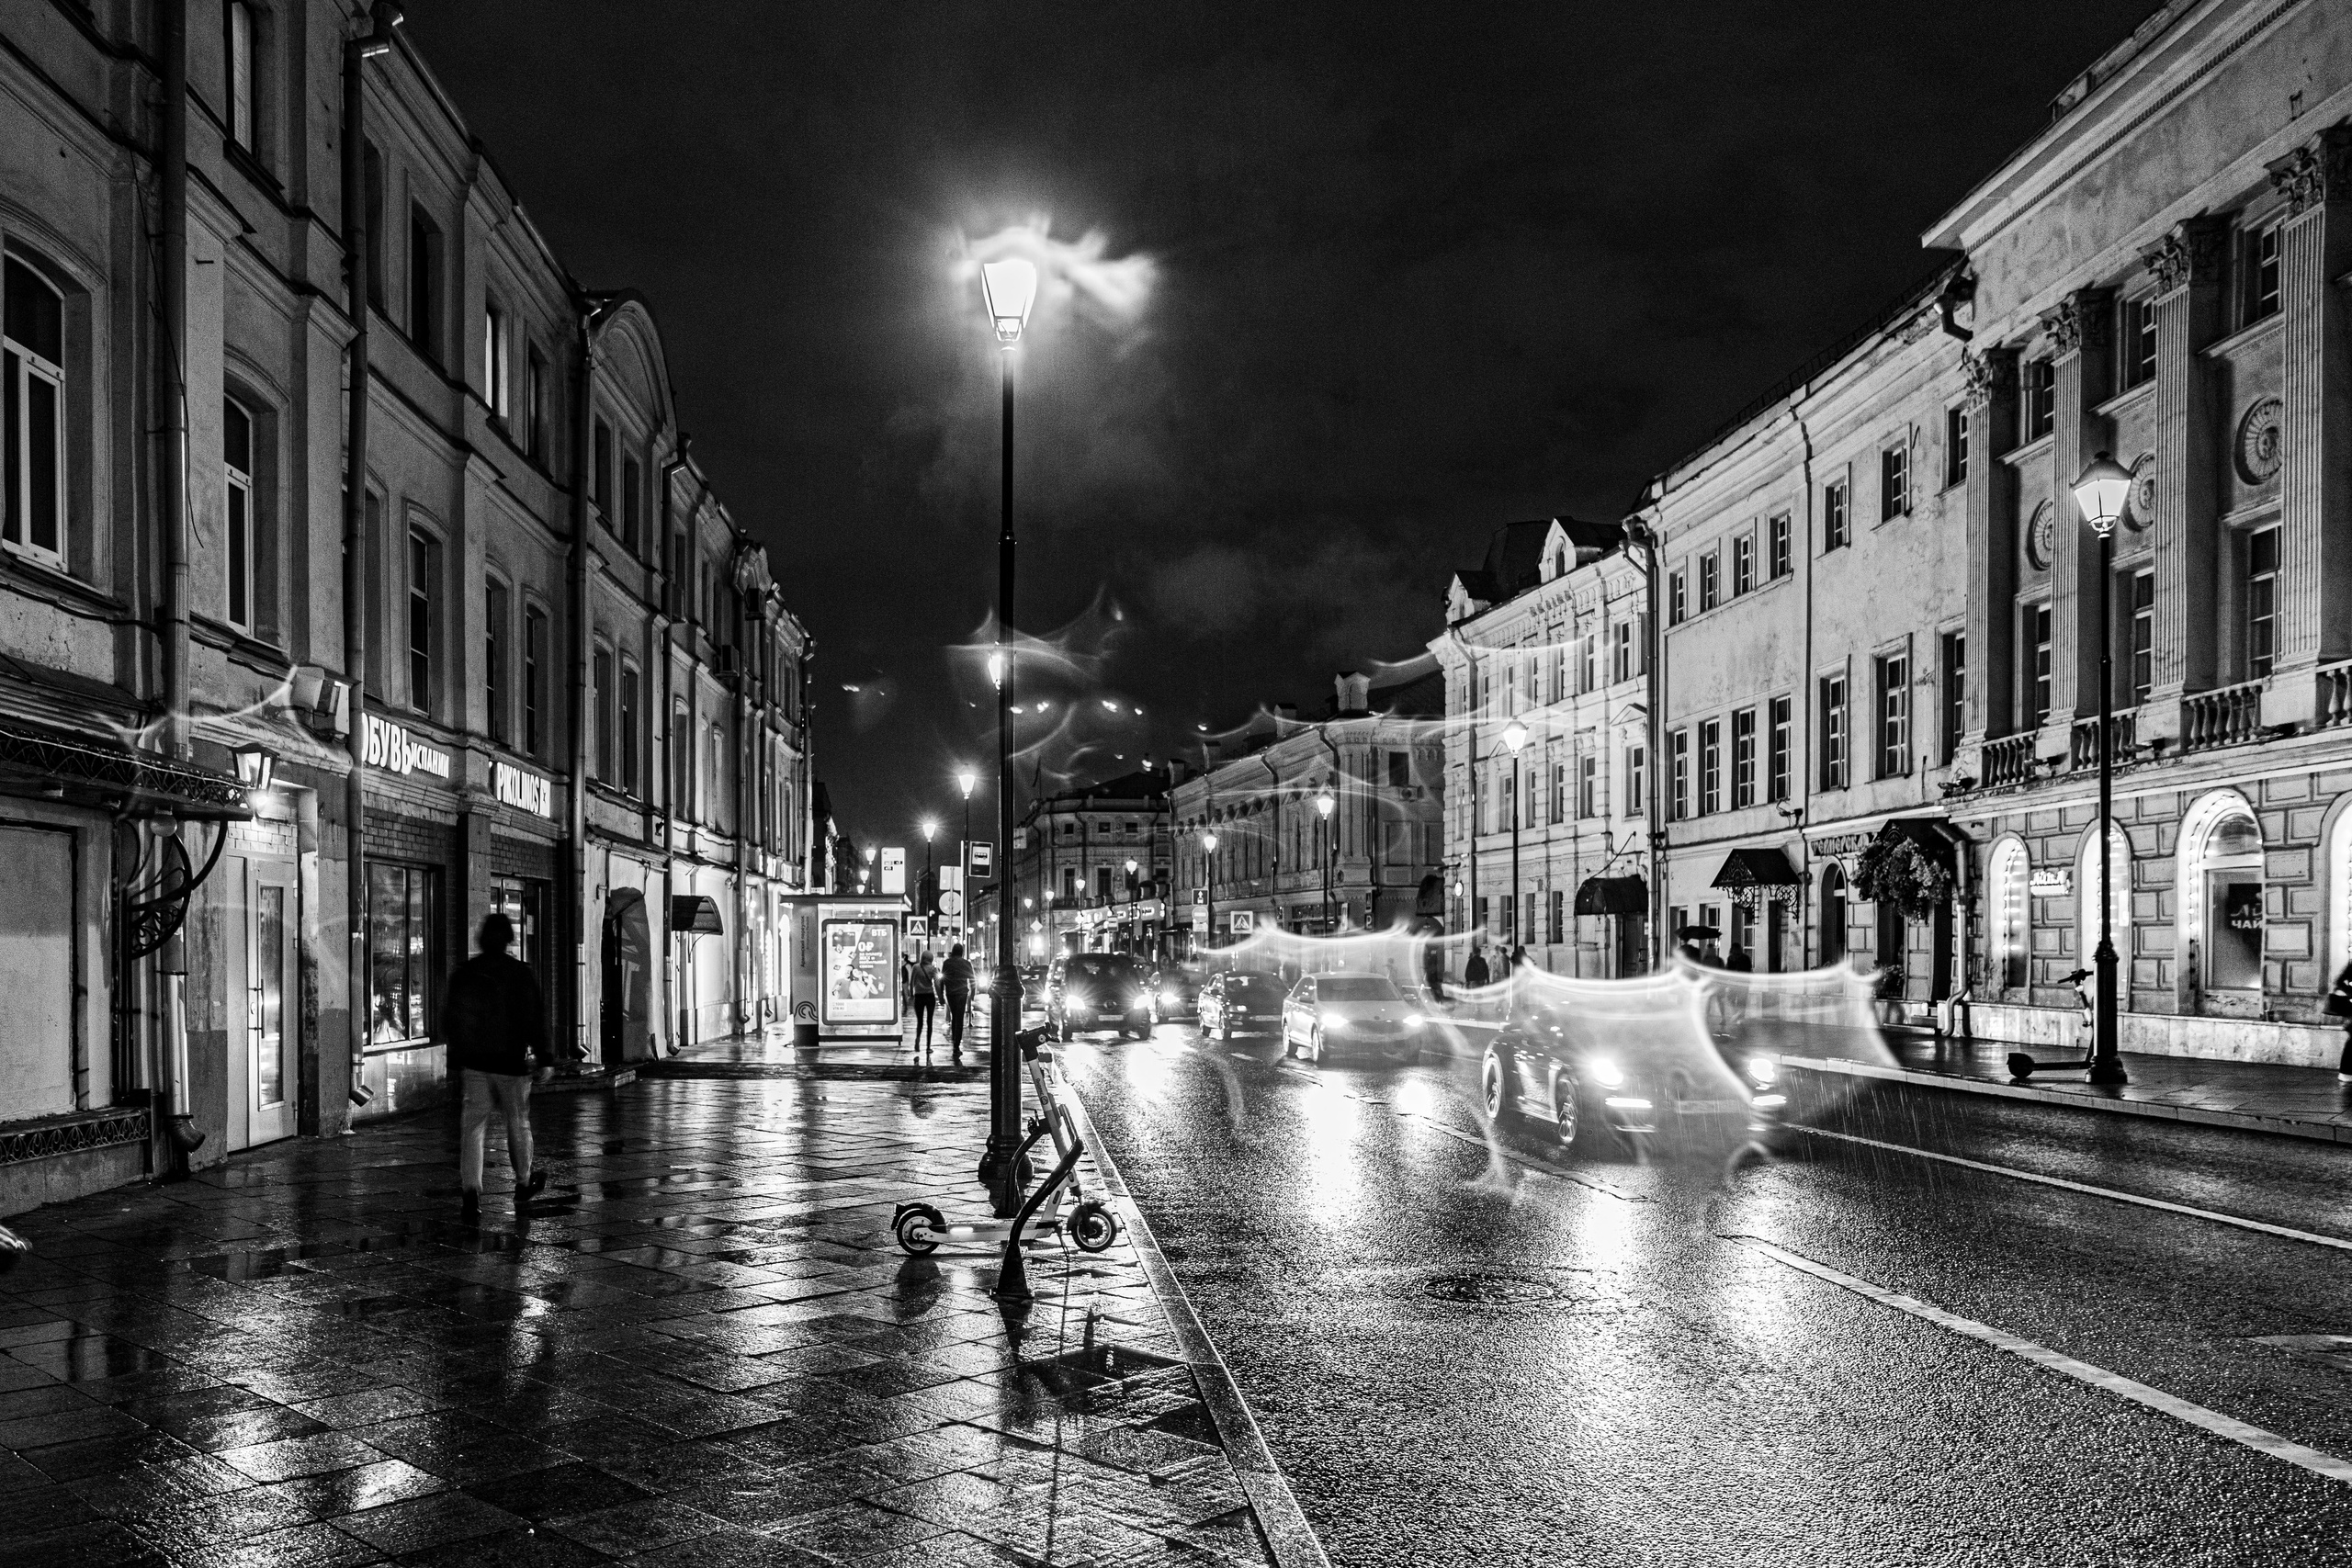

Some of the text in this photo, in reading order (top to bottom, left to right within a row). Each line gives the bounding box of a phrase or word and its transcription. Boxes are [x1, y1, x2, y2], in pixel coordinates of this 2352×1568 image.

[362, 712, 449, 779] ОБУВЬ ИСПАНИИ
[497, 761, 539, 814] PIKOLINOS
[871, 928, 888, 937] ВТБ
